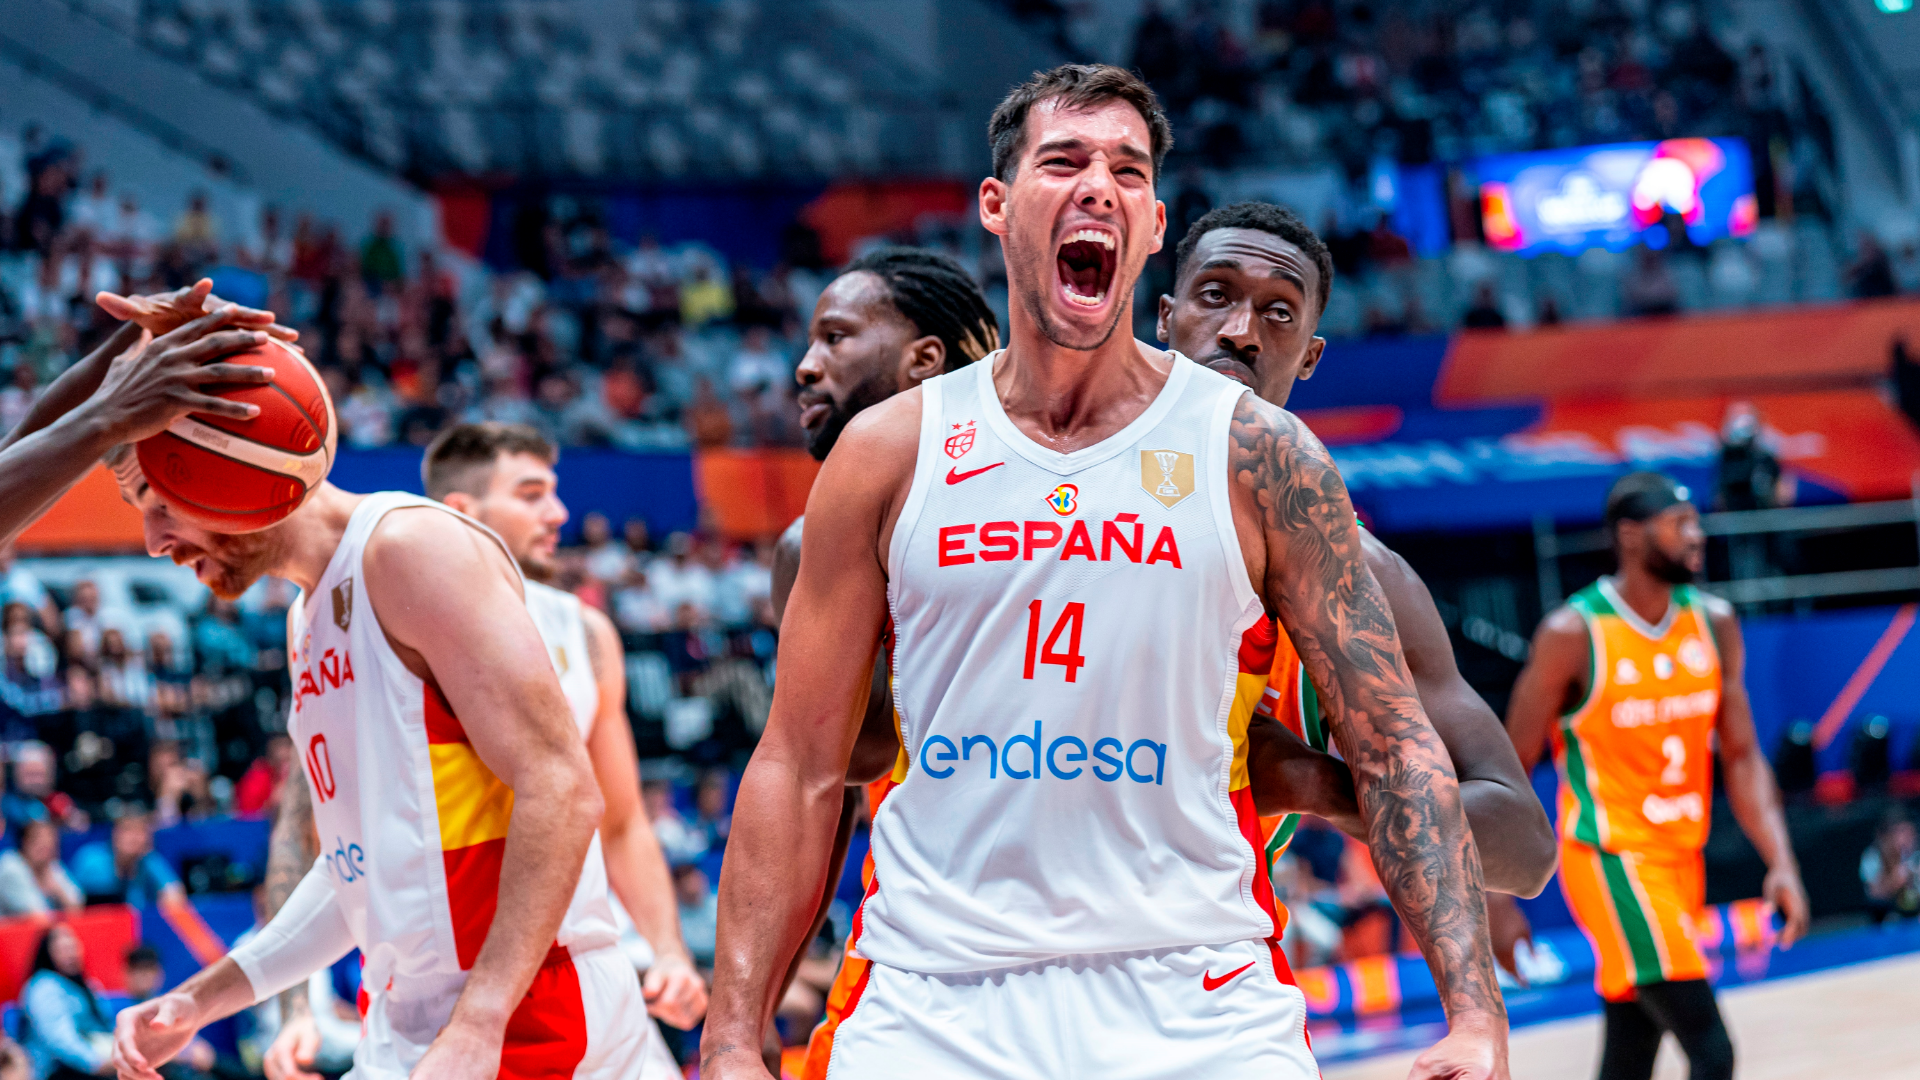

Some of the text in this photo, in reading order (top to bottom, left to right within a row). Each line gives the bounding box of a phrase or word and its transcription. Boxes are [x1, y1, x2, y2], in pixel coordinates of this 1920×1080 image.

[938, 512, 1183, 570] ESPAÑA
[1023, 598, 1086, 684] 14
[294, 646, 355, 714] SPAÑA
[306, 733, 336, 803] 10
[920, 720, 1168, 786] endesa
[1660, 734, 1687, 785] 2
[326, 836, 365, 886] nde
